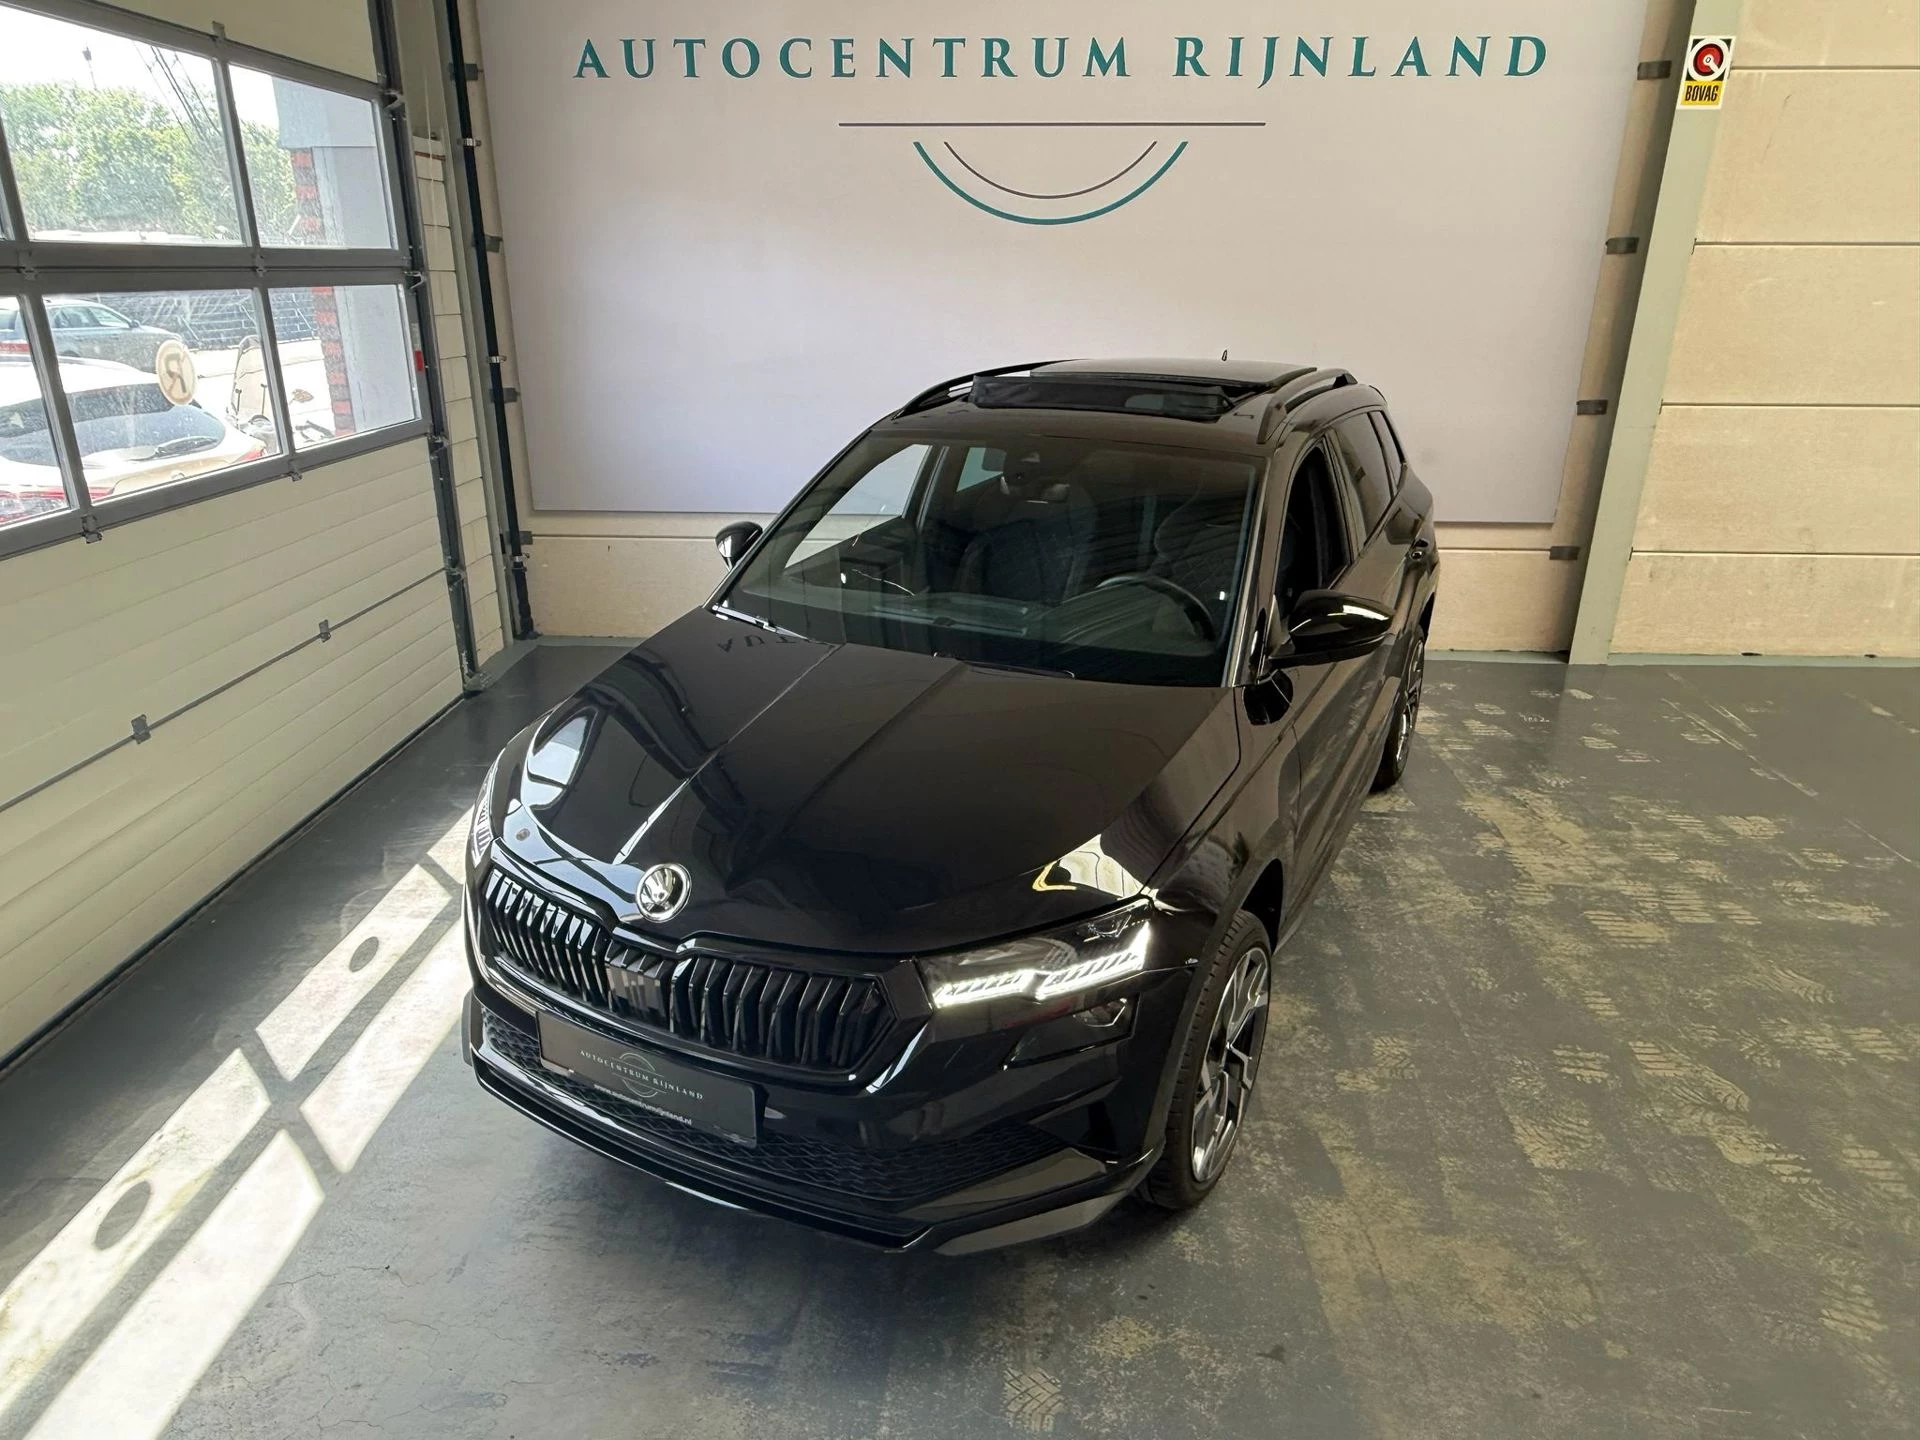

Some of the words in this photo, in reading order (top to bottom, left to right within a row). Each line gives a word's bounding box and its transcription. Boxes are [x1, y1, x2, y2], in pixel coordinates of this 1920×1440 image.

[573, 36, 1131, 79] AUTOCENTRUM
[1173, 36, 1547, 89] RIJNLAND
[1685, 85, 1719, 102] BOVAG
[580, 1050, 649, 1081] AUTOCENTRUM
[653, 1078, 703, 1100] RIJNLAND
